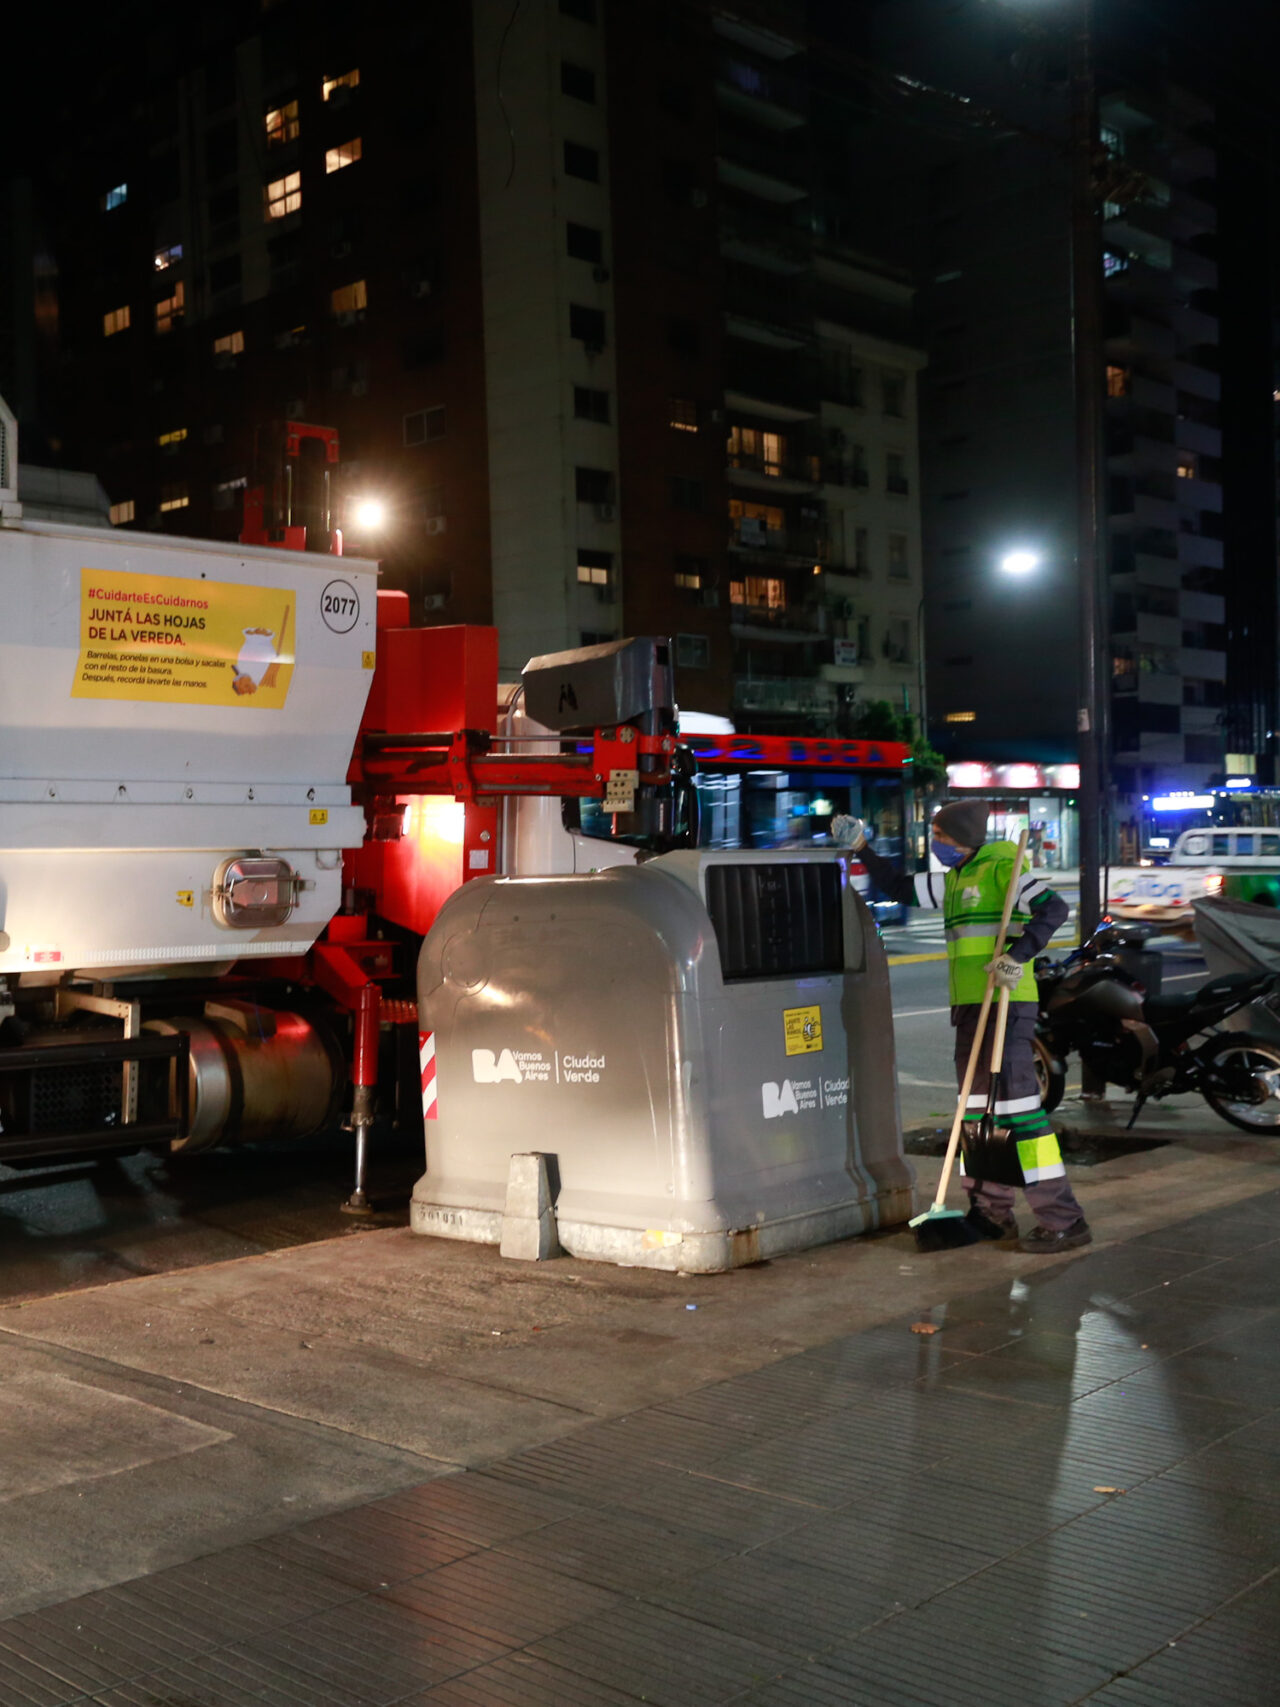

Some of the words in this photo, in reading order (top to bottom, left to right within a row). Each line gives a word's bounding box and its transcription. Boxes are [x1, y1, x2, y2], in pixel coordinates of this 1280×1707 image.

[88, 588, 209, 610] #CuidarteEsCuidarnos
[324, 595, 356, 616] 2077
[88, 607, 133, 624] JUNTÁ
[136, 613, 161, 626] LAS
[164, 615, 206, 630] HOJAS
[88, 626, 107, 640] DE
[110, 628, 127, 641] LA
[130, 630, 186, 646] VEREDA.
[119, 653, 148, 664] ponelas
[160, 656, 174, 664] una
[175, 656, 195, 666] bolsa
[201, 659, 226, 668] sacalas
[100, 662, 108, 671] el
[108, 664, 128, 672] resto
[128, 664, 139, 673] de
[139, 665, 147, 673] la
[116, 675, 145, 684] recordá
[146, 677, 171, 686] lavarte
[171, 679, 182, 687] las
[512, 1051, 542, 1061] Vamos
[563, 1055, 605, 1068] Ciudad
[472, 1048, 523, 1084] BA
[519, 1061, 551, 1071] Buenos
[523, 1070, 549, 1081] Aires
[564, 1070, 600, 1083] Verde
[791, 1080, 811, 1090] Vamos
[824, 1077, 850, 1092] Ciudad
[762, 1078, 799, 1119] BA
[795, 1089, 817, 1100] Buenos
[825, 1093, 848, 1106] Verde
